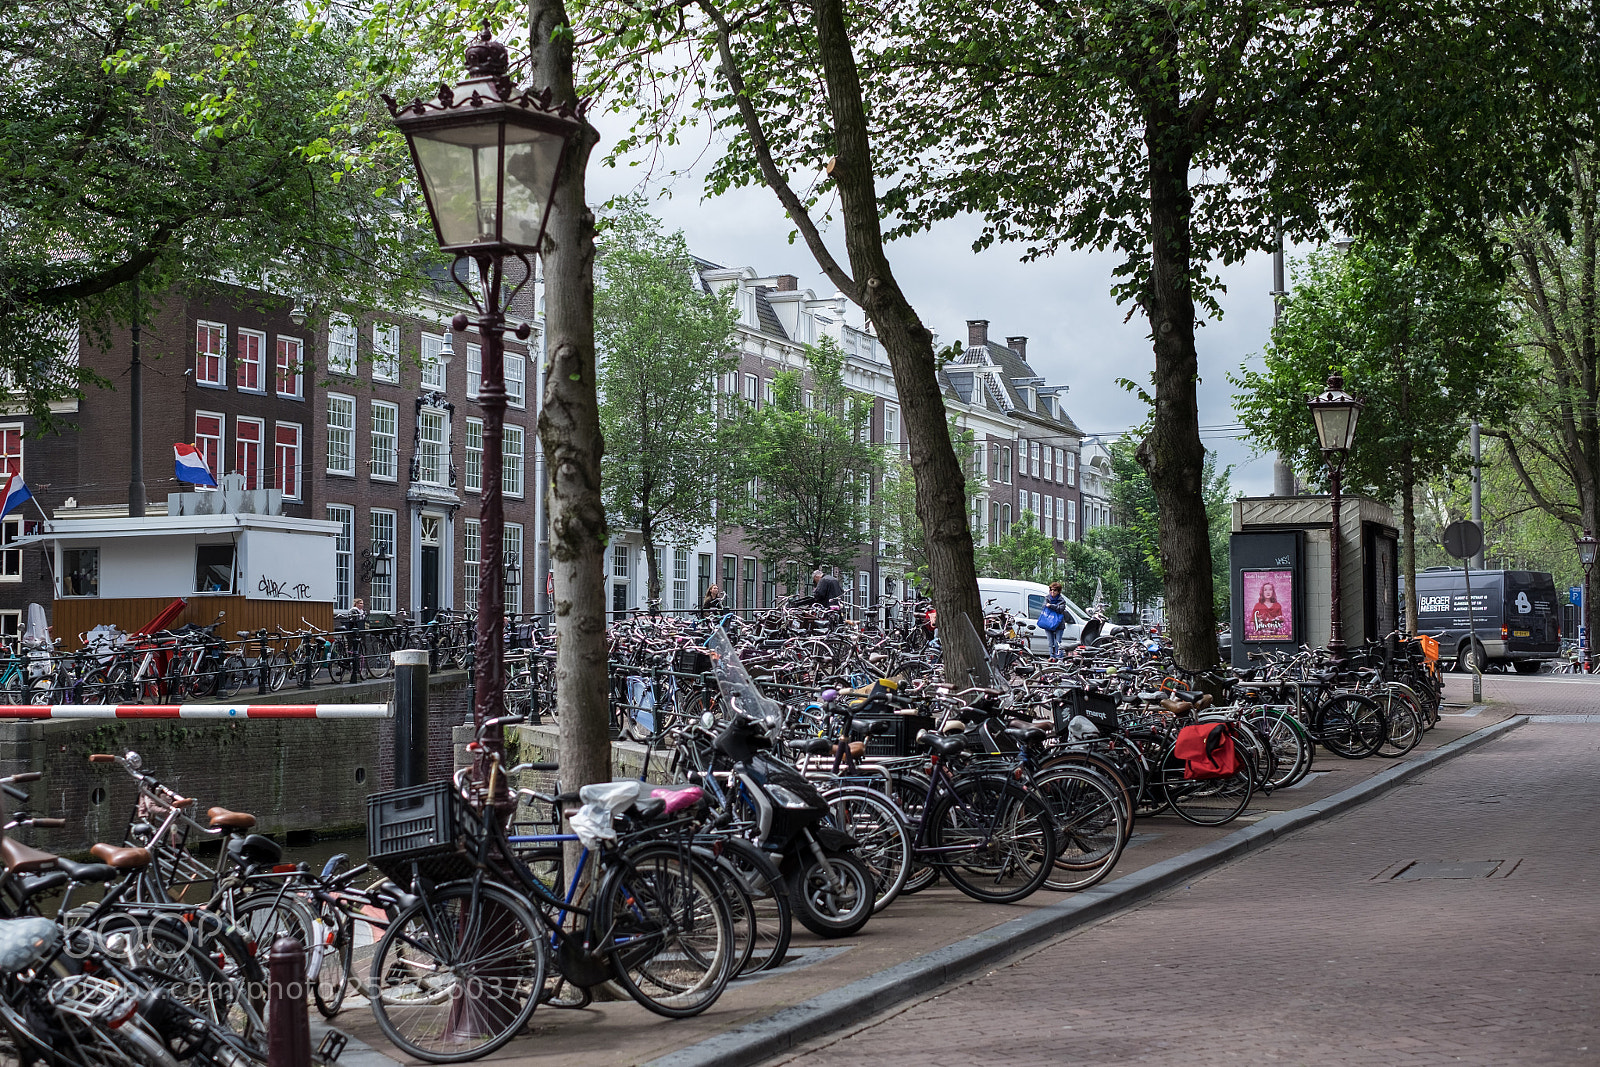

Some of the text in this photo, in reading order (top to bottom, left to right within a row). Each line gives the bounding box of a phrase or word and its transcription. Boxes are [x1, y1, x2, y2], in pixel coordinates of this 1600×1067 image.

[1421, 596, 1450, 605] BURGER
[1420, 604, 1450, 612] MEESTER
[1085, 709, 1107, 720] marqt
